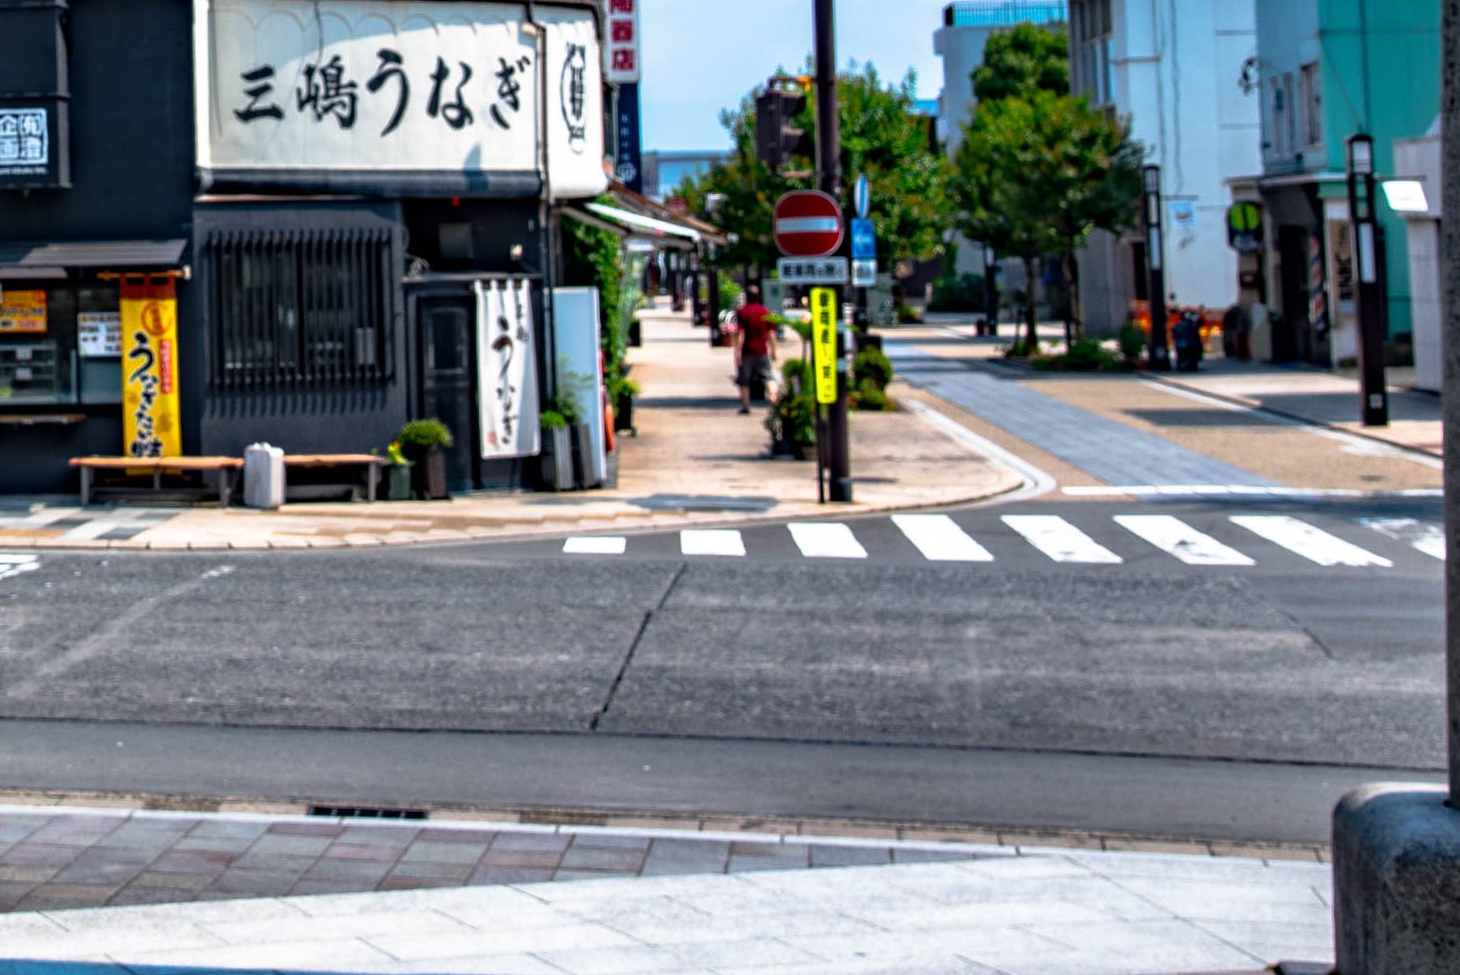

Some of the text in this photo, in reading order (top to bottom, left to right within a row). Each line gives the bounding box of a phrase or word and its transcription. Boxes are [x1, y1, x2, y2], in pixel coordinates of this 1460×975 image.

[234, 48, 531, 137] 三嶋うなぎ
